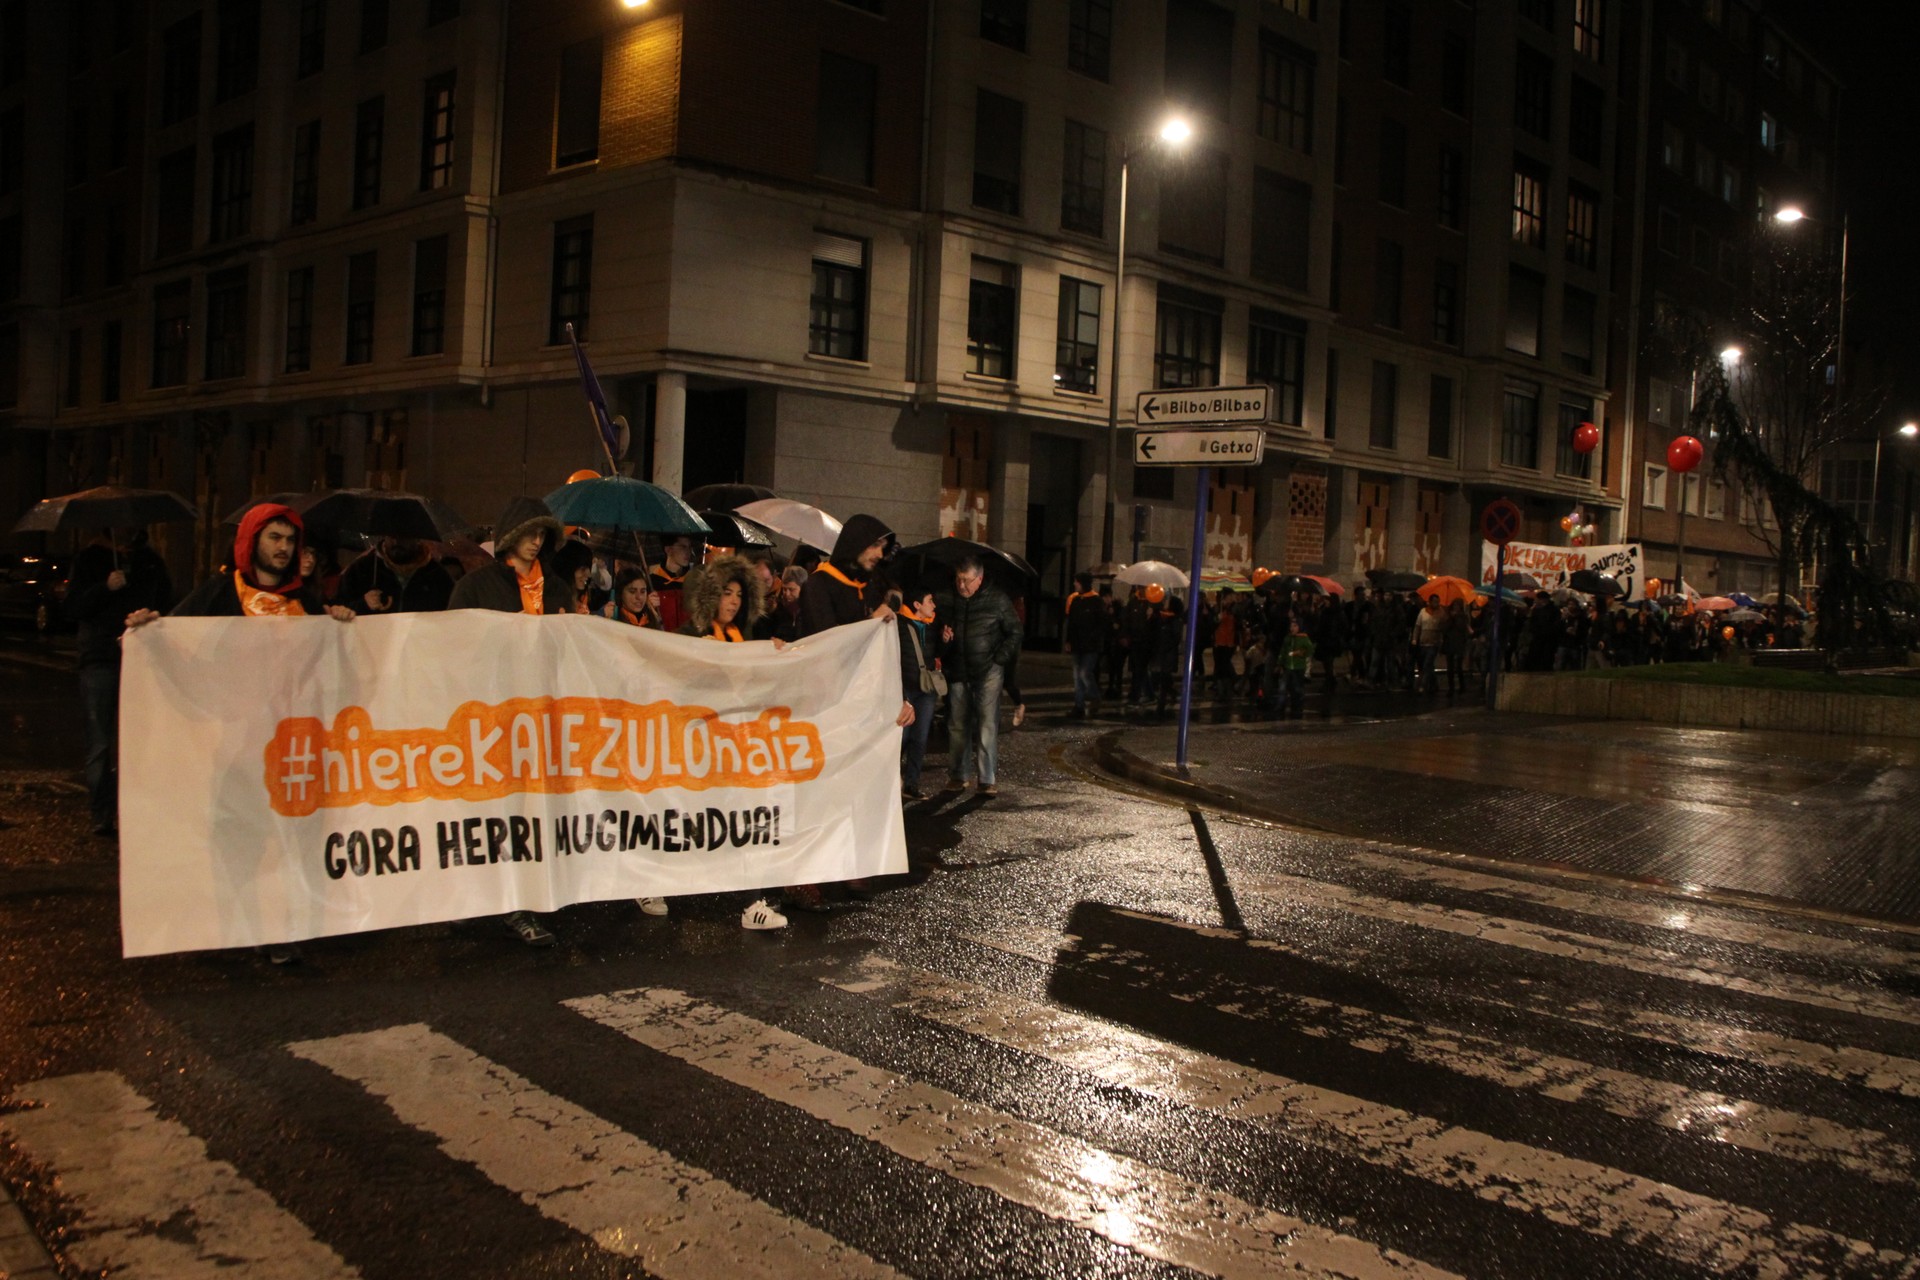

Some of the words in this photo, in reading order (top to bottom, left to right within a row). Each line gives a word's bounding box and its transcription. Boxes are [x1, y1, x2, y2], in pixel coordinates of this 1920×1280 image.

[1170, 399, 1261, 414] Bilbo/Bilbao
[1210, 441, 1253, 454] Getxo
[324, 825, 421, 880] GORA
[437, 815, 543, 869] HERRI
[555, 805, 781, 856] MUGIMENDUA!
